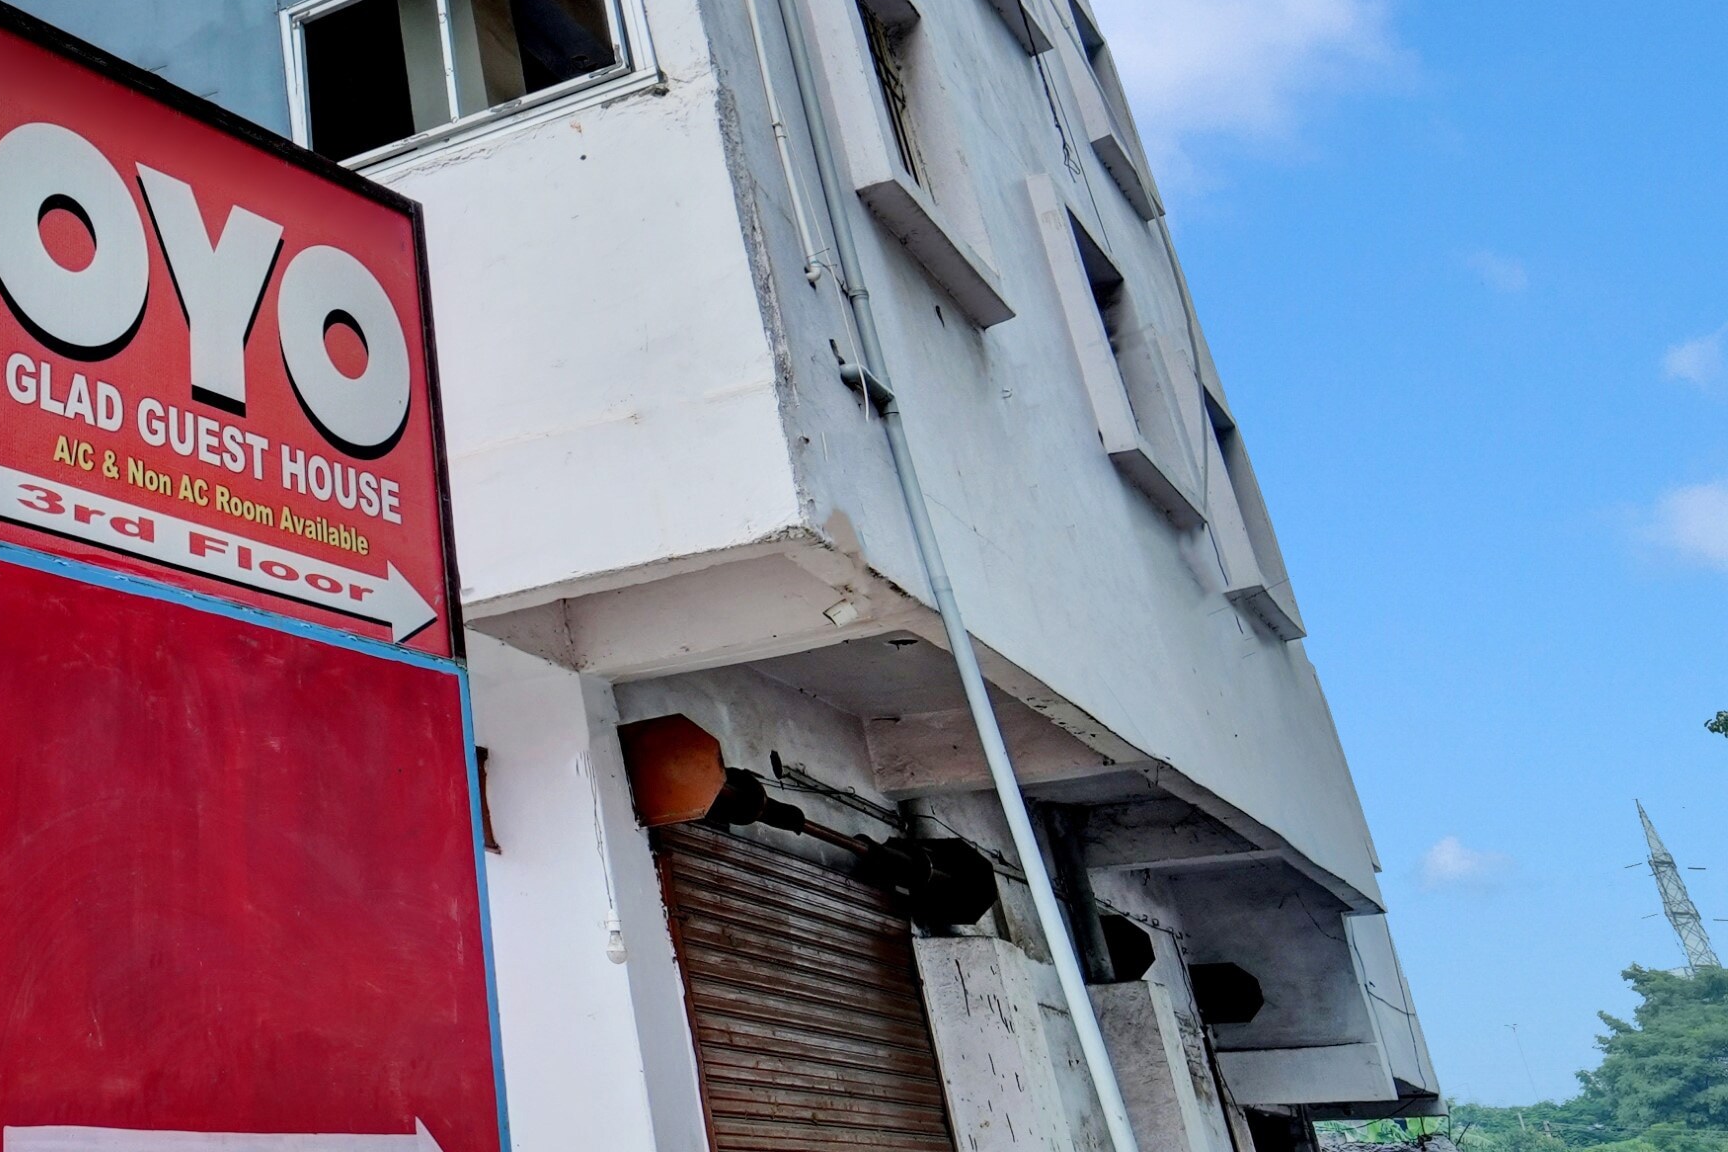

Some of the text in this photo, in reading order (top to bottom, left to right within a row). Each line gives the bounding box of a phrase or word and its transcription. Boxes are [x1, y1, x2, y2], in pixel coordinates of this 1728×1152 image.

[6, 352, 402, 525] GLAD GUEST HOUSE
[53, 435, 369, 556] A/C & Non AC Room Available
[17, 483, 375, 603] 3rd Floor
